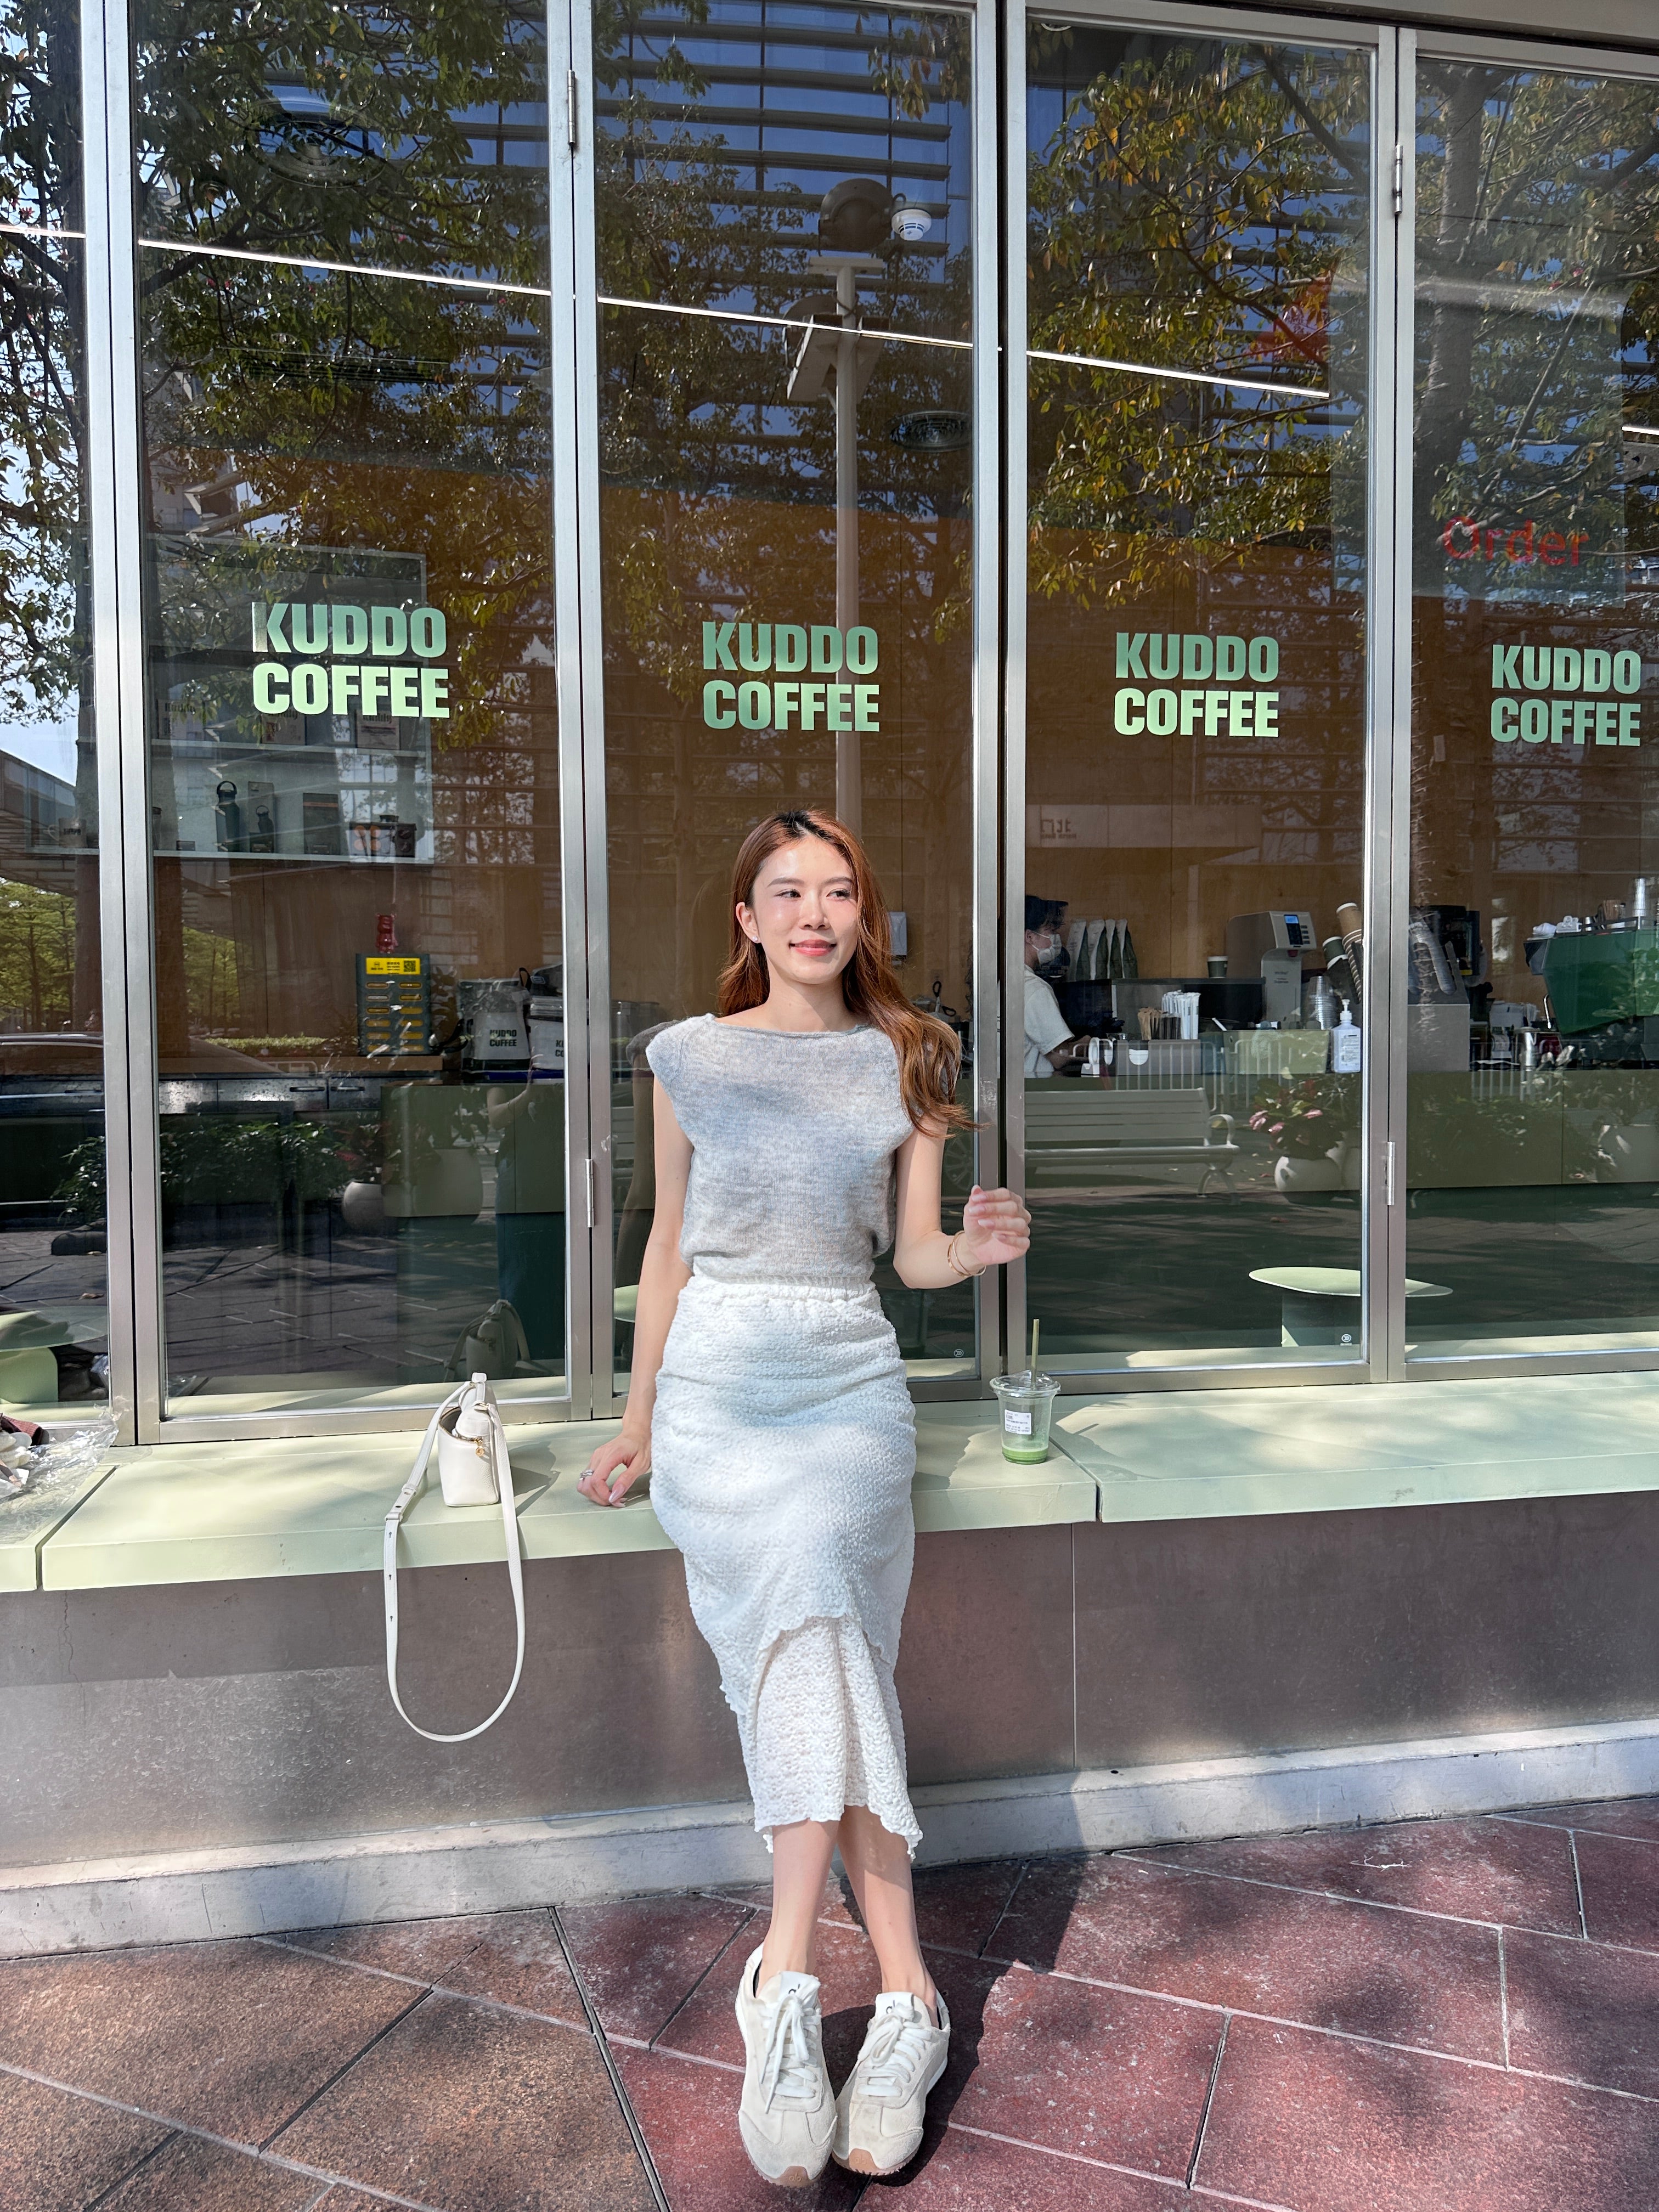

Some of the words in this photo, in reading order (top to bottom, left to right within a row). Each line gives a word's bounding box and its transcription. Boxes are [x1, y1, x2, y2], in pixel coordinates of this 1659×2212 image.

[1443, 516, 1589, 567] Order
[252, 602, 447, 658] KUDDO
[702, 622, 878, 674] KUDDO
[1116, 633, 1279, 682] KUDDO
[1492, 645, 1641, 695] KUDDO
[253, 663, 449, 718] COFFEE
[703, 680, 879, 732] COFFEE
[1114, 688, 1279, 737] COFFEE
[1491, 697, 1641, 747] COFFEE
